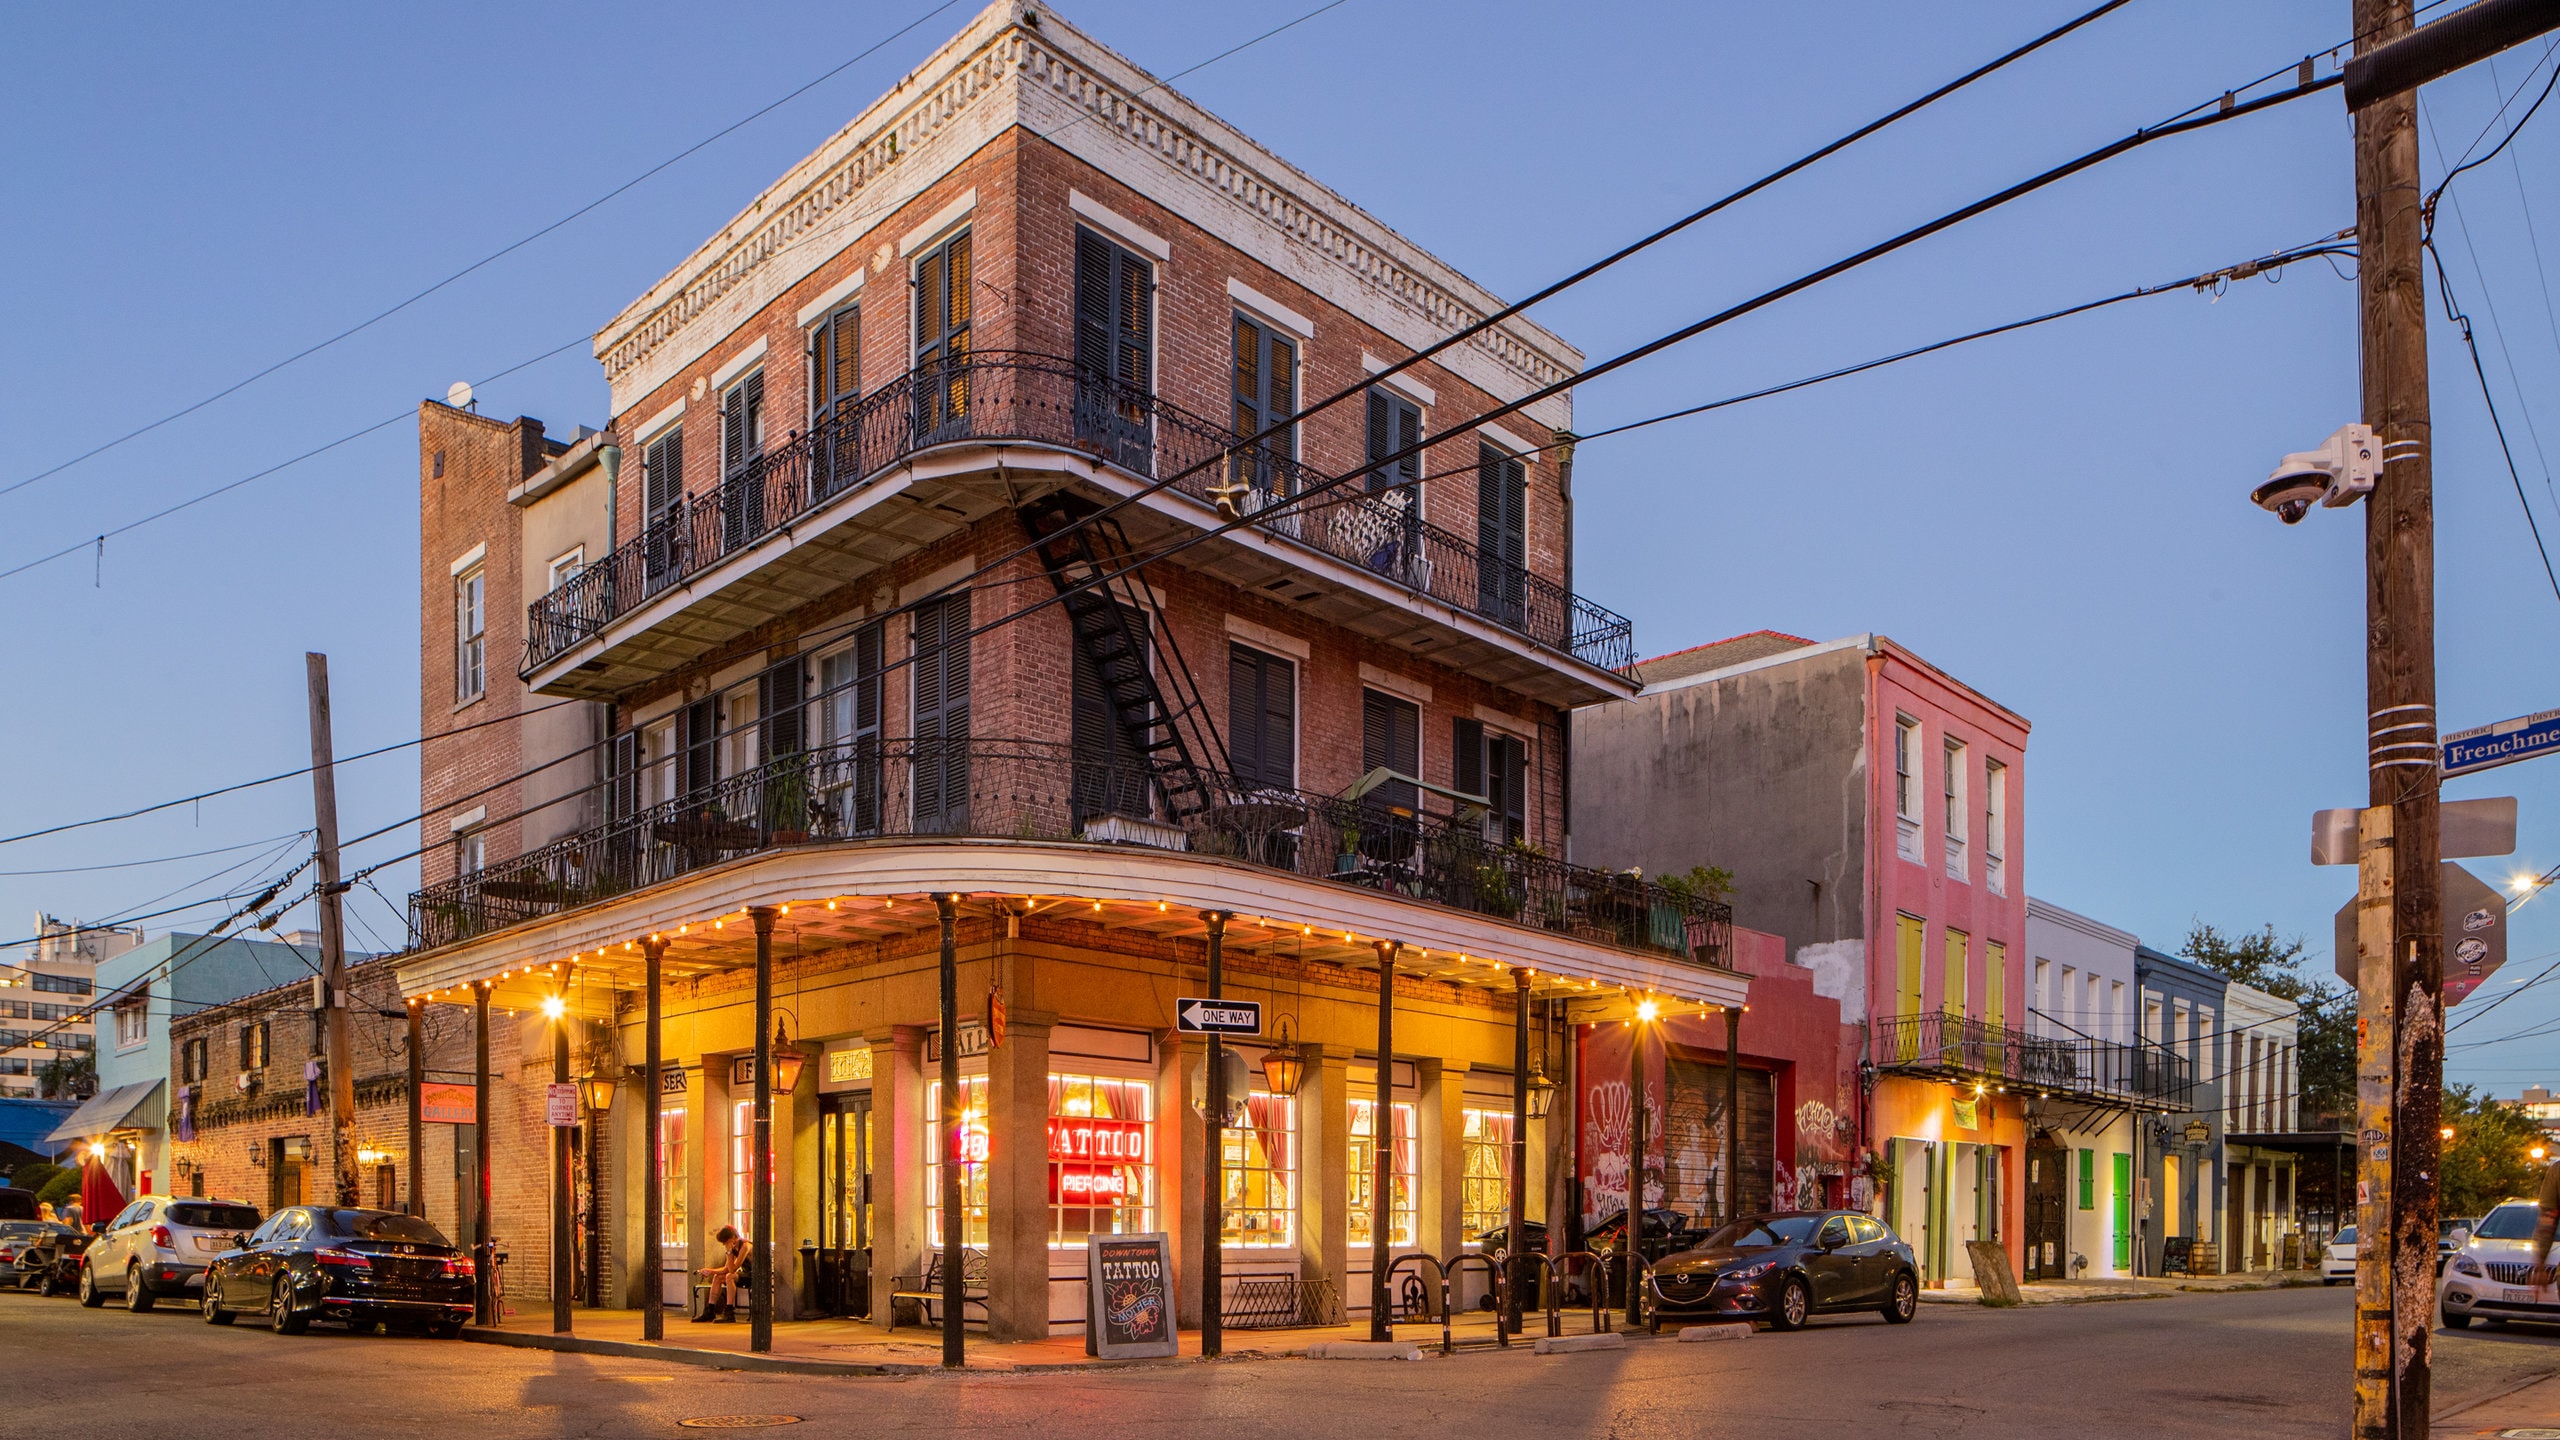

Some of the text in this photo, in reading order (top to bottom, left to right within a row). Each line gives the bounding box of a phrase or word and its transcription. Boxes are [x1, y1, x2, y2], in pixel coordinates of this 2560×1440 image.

[2445, 726, 2490, 742] HISTORIC
[2450, 729, 2560, 764] Frenchme
[1203, 1009, 1251, 1024] ONE WAY
[423, 1105, 475, 1120] GALLERY
[1062, 1174, 1124, 1194] PIERCING
[1102, 1247, 1158, 1258] DOWNTOWN
[1103, 1260, 1160, 1280] TATTOO
[1117, 1297, 1158, 1322] MOTHER
